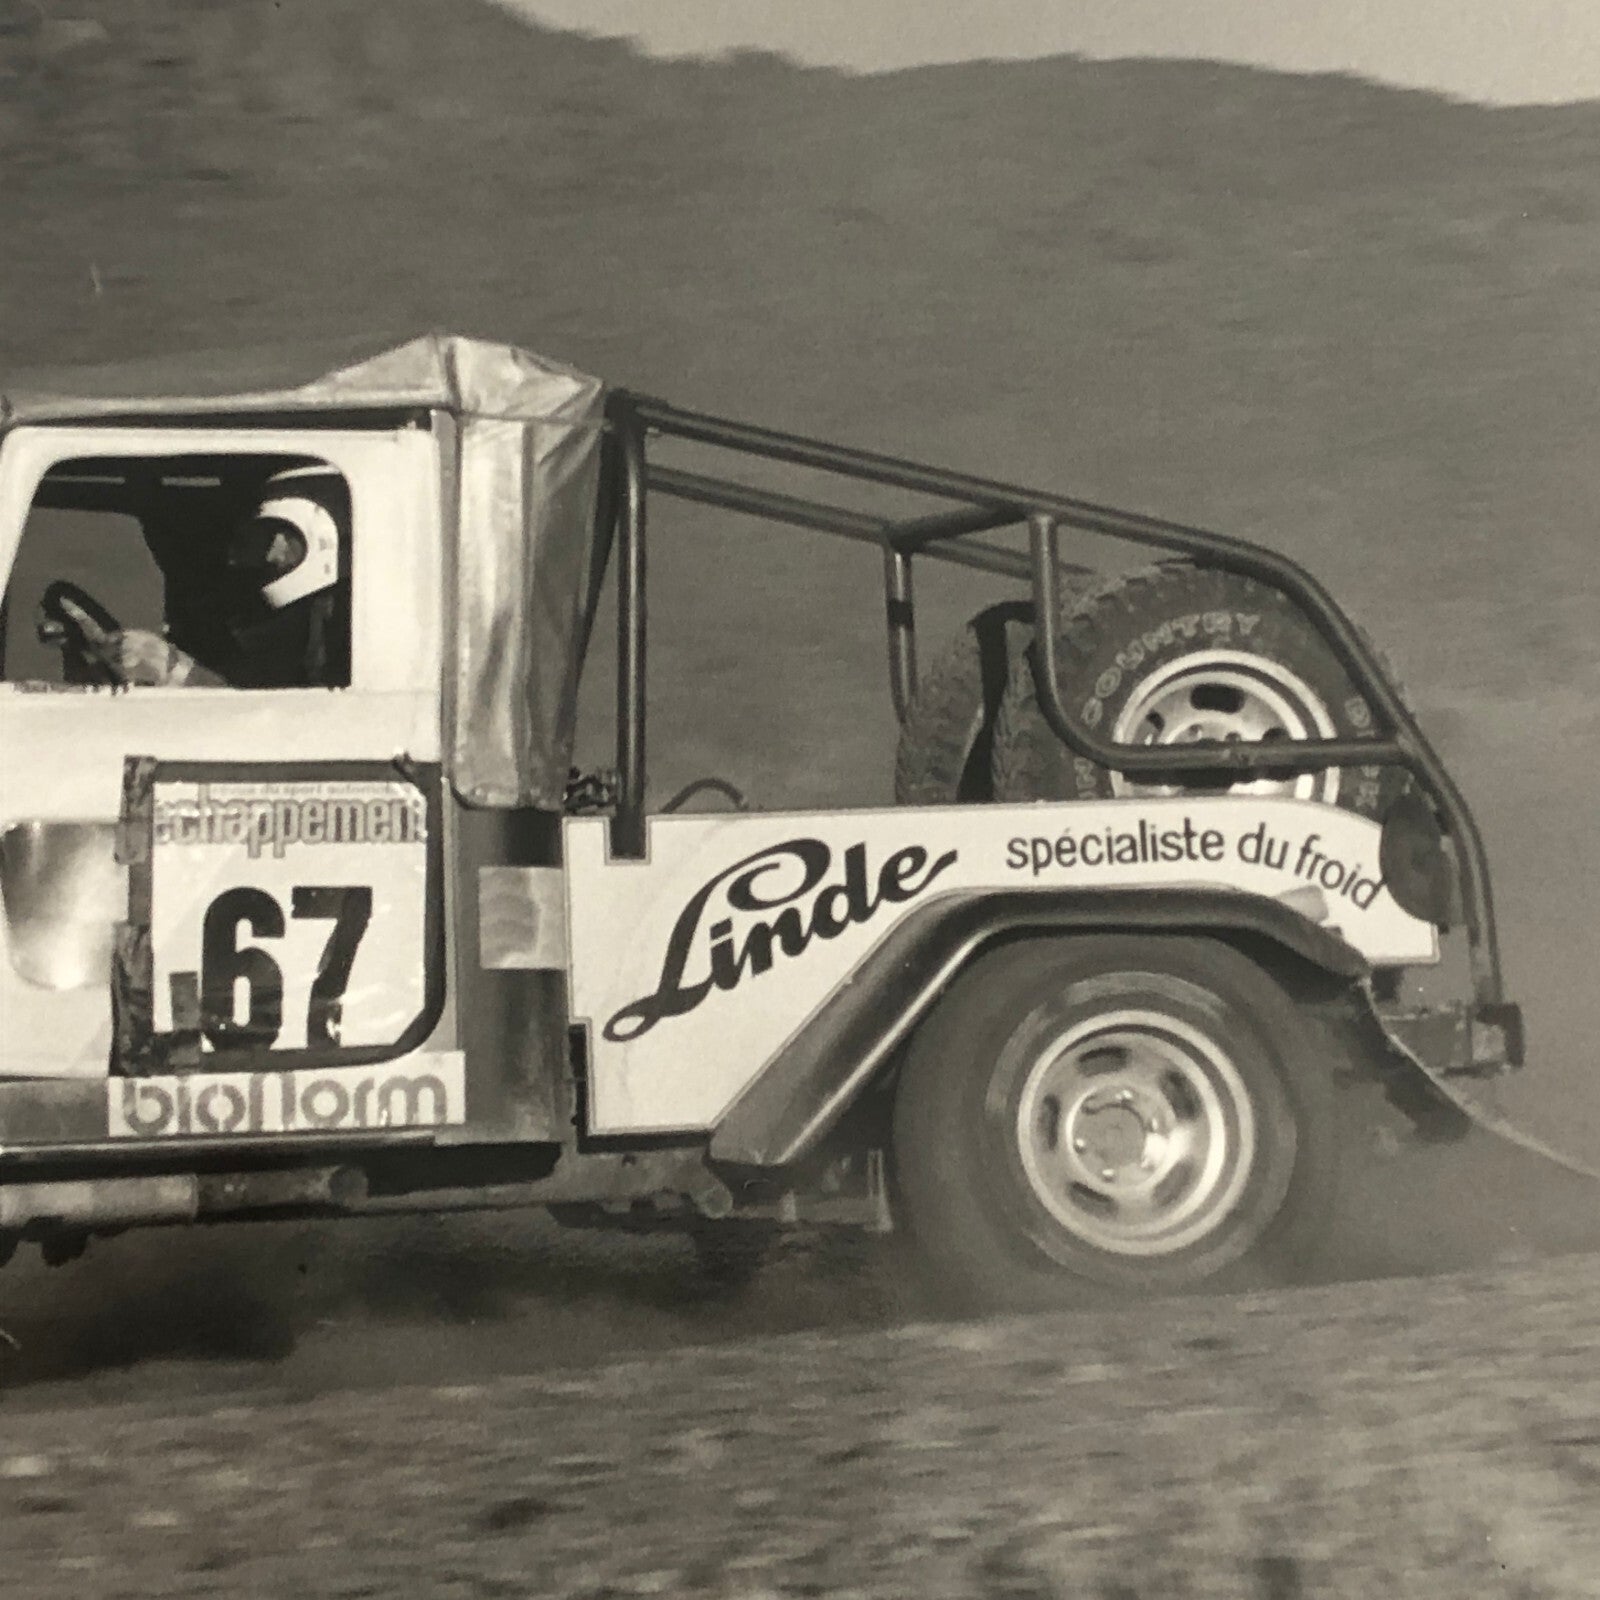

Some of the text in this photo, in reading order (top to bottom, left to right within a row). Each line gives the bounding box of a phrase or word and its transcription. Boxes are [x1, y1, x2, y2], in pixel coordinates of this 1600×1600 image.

[602, 837, 958, 1042] Linde
[1006, 817, 1384, 911] spécialiste du froid
[202, 886, 373, 1051] 67
